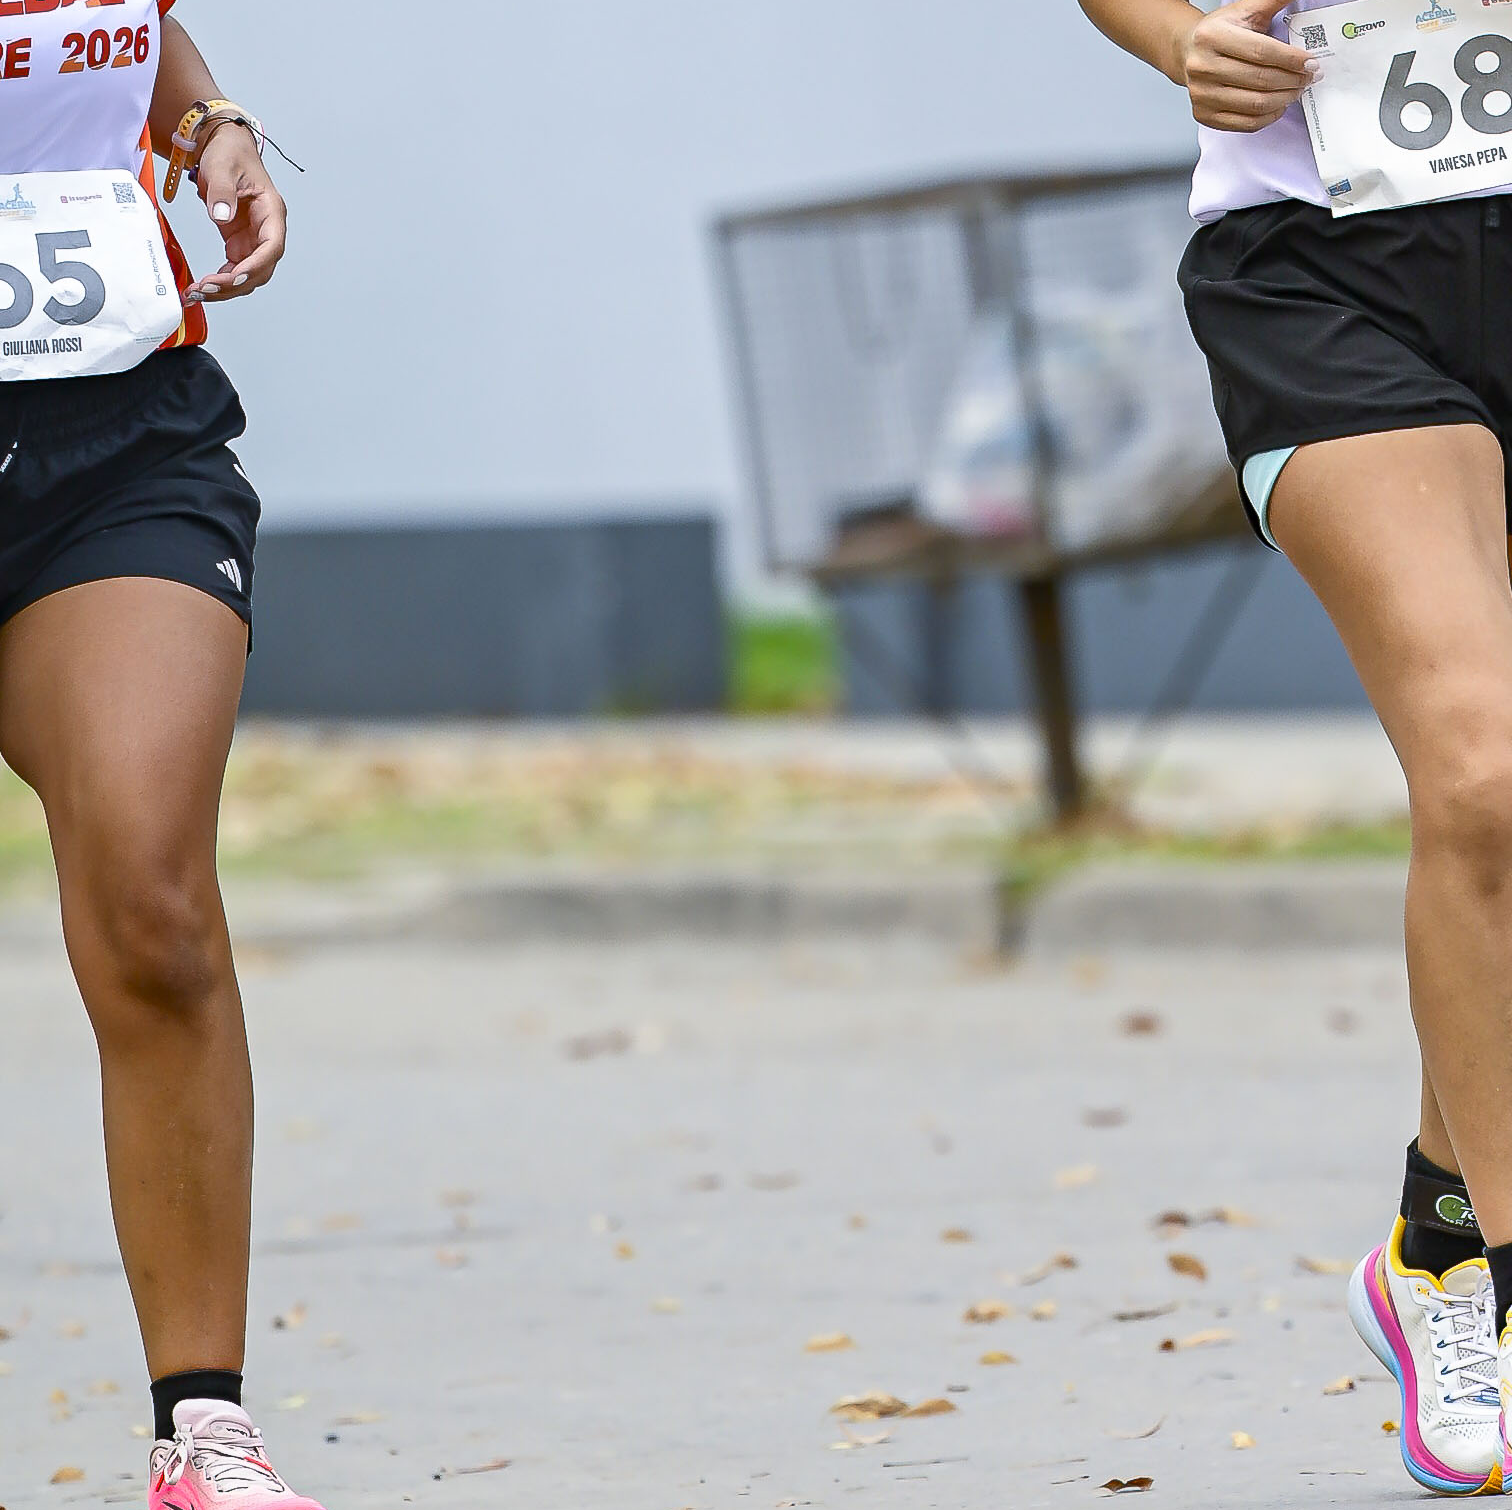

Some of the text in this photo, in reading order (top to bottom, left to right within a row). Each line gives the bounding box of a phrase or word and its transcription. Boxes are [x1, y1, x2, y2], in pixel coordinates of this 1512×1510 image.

[58, 23, 149, 74] 2026
[1429, 146, 1507, 173] VANESA PEPA
[3, 336, 83, 356] GIULIANA ROSSI
